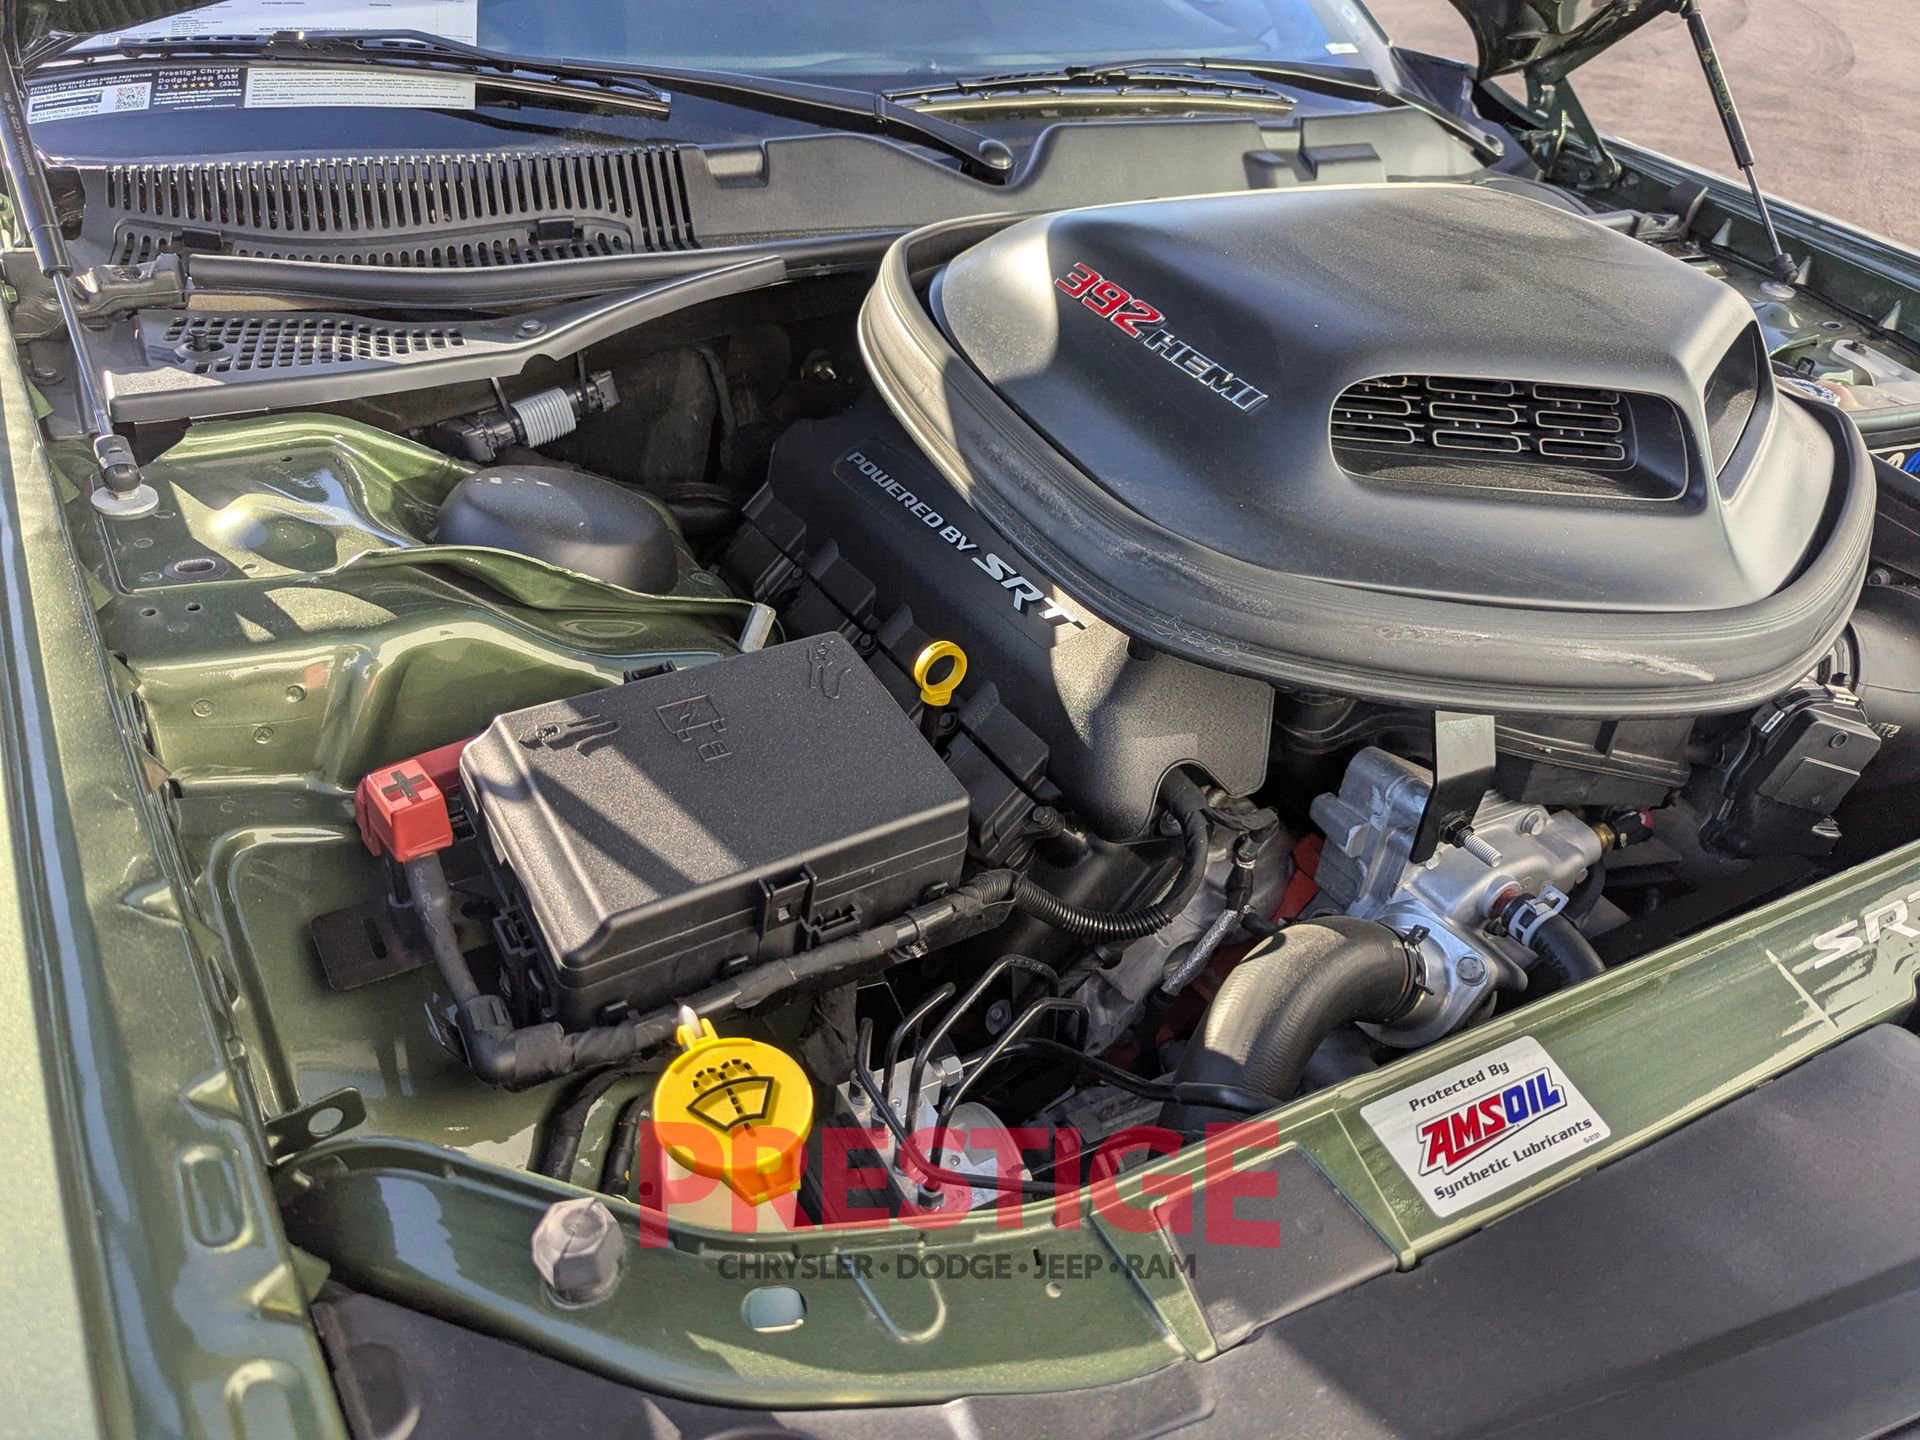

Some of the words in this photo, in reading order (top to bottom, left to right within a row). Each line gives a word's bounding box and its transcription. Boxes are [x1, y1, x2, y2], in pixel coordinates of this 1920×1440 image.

[158, 76, 188, 84] Dodge
[159, 69, 197, 77] Prestige
[200, 67, 239, 75] Chrysler
[1054, 261, 1166, 340] 392
[1143, 328, 1268, 411] HEMI
[846, 451, 944, 528] POWERED
[939, 525, 978, 552] BY
[971, 552, 1086, 630] SRT
[1813, 890, 1920, 970] SR
[1408, 1070, 1486, 1112] Protected
[1487, 1061, 1510, 1077] By
[1421, 1072, 1562, 1168] AMSOIL
[1433, 1157, 1512, 1200] Synthetic
[1512, 1117, 1593, 1163] Lubricants
